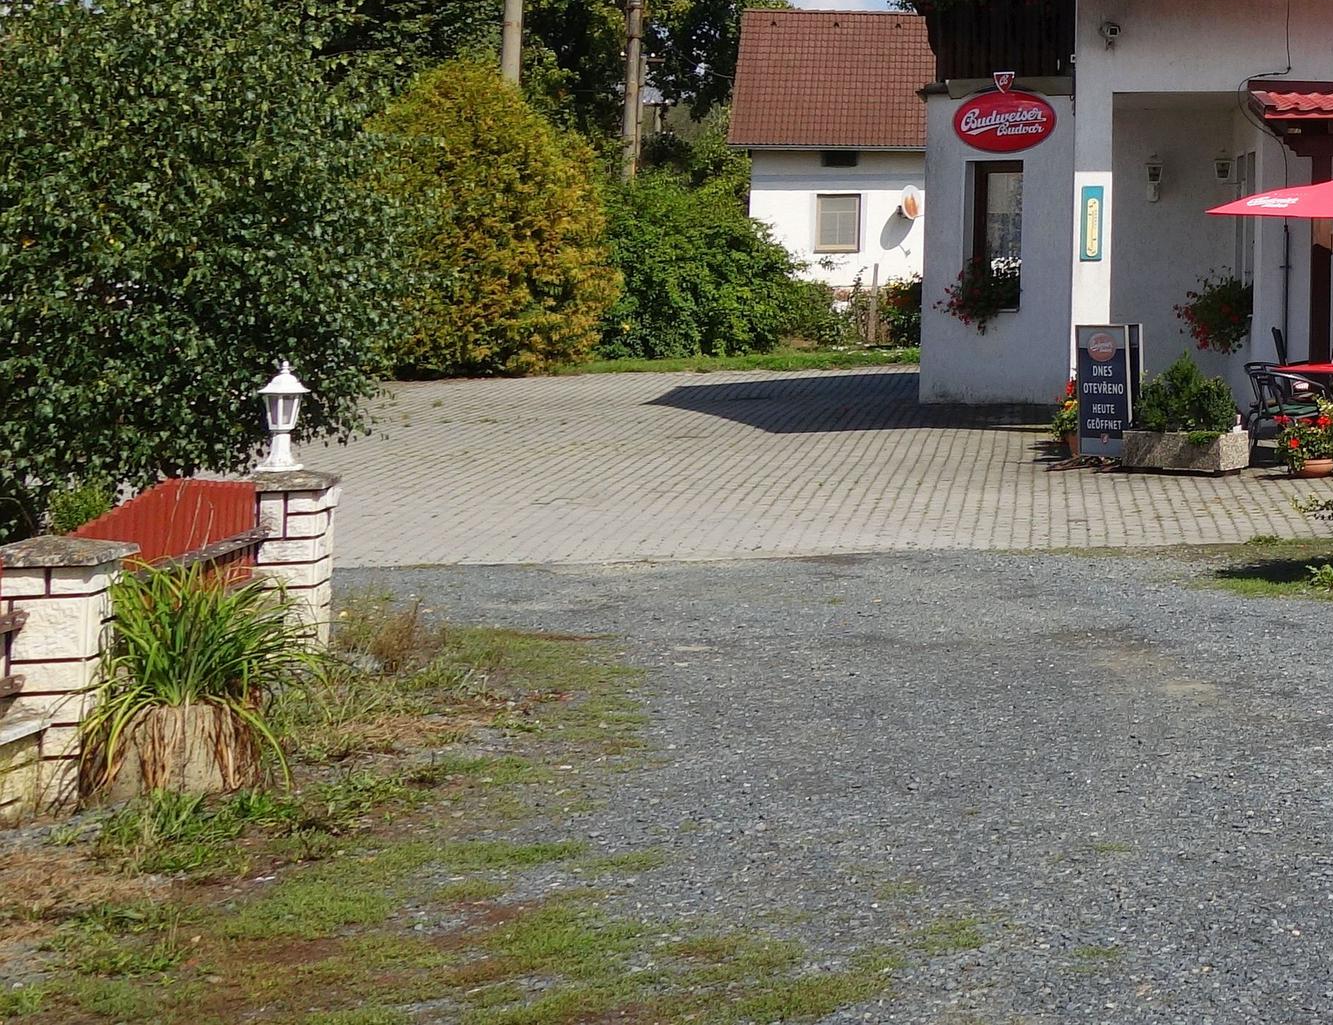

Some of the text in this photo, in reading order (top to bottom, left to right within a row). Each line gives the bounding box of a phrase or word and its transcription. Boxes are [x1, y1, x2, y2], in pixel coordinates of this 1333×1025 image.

[961, 108, 1046, 133] Budweiser
[997, 122, 1044, 136] Budvar
[1093, 365, 1112, 376] DNES
[1083, 381, 1123, 394] OTEVŘENO
[1092, 403, 1115, 414] HEUTE
[1086, 417, 1122, 430] GEÖFFNET
